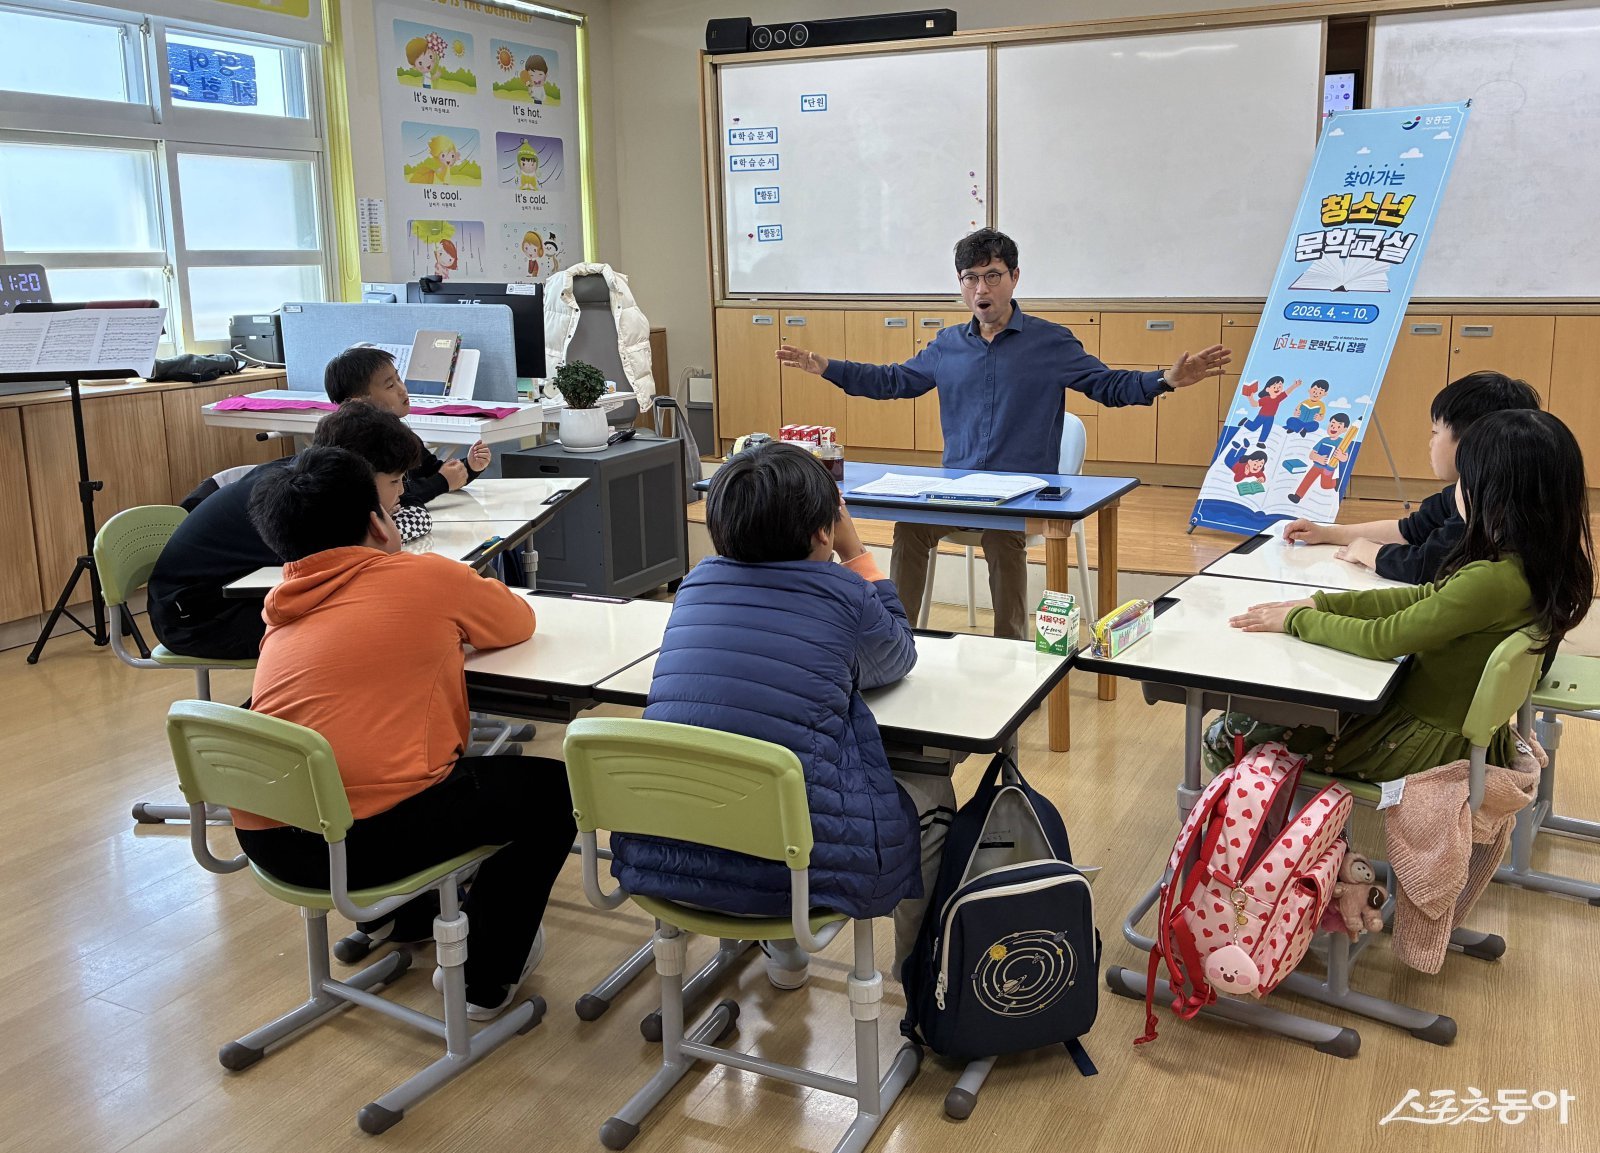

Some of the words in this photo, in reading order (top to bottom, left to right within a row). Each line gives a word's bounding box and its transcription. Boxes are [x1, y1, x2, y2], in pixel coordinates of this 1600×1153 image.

[413, 91, 428, 104] It's
[430, 95, 460, 108] warm.
[808, 97, 825, 108] 단원
[512, 104, 525, 116] It's
[527, 106, 542, 119] hot.
[738, 130, 774, 141] 학습문제
[739, 156, 775, 168] 학습순서
[1343, 169, 1406, 187] 찾아가는
[423, 188, 438, 201] It's
[440, 190, 462, 201] cool.
[515, 193, 527, 204] It's
[529, 194, 549, 205] cold.
[1320, 191, 1416, 227] 청소년
[1295, 228, 1417, 264] 문학교실
[1291, 305, 1323, 318] 2026.
[1327, 306, 1336, 319] 4.
[1353, 307, 1368, 320] 10.
[1308, 339, 1346, 352] 문학도시
[1346, 342, 1367, 354] 장흥
[1039, 614, 1066, 625] 서울우유
